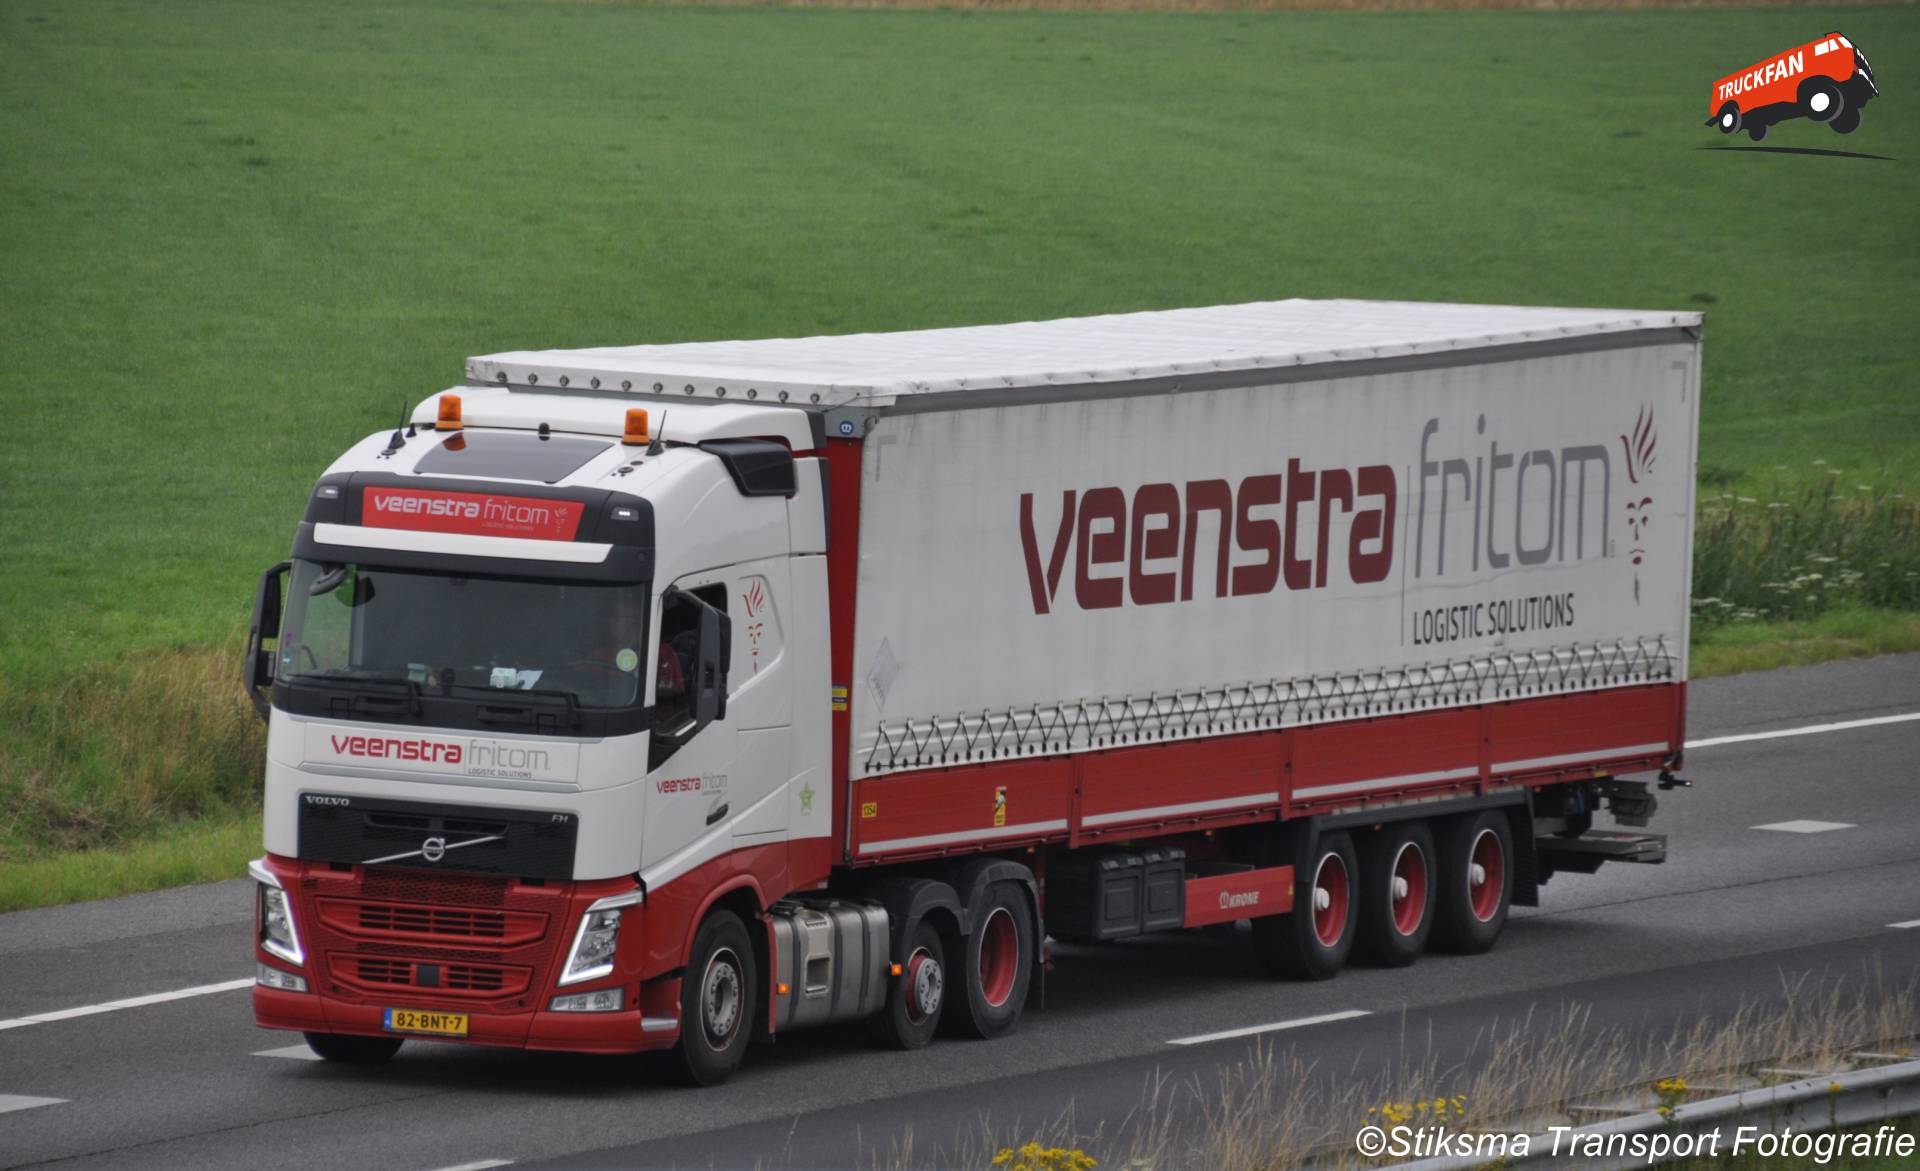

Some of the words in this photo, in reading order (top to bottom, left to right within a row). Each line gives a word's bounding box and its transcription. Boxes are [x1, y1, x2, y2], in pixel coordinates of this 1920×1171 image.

[374, 495, 480, 518] veenstra
[483, 498, 549, 525] fritom
[1020, 458, 1397, 615] veenstra
[1414, 414, 1610, 579] fritom
[1414, 603, 1484, 645] LOGISTIC
[1488, 593, 1574, 635] SOLUTIONS
[331, 735, 463, 764] veenstra
[468, 739, 549, 770] fritom
[468, 768, 496, 777] LOGISTIC
[498, 769, 532, 779] SOLUTIONS
[656, 777, 702, 794] veenstra
[305, 795, 350, 807] VOLVO
[552, 814, 569, 823] FH
[1229, 891, 1260, 908] KRONE
[396, 1012, 463, 1031] 82-BNT-7
